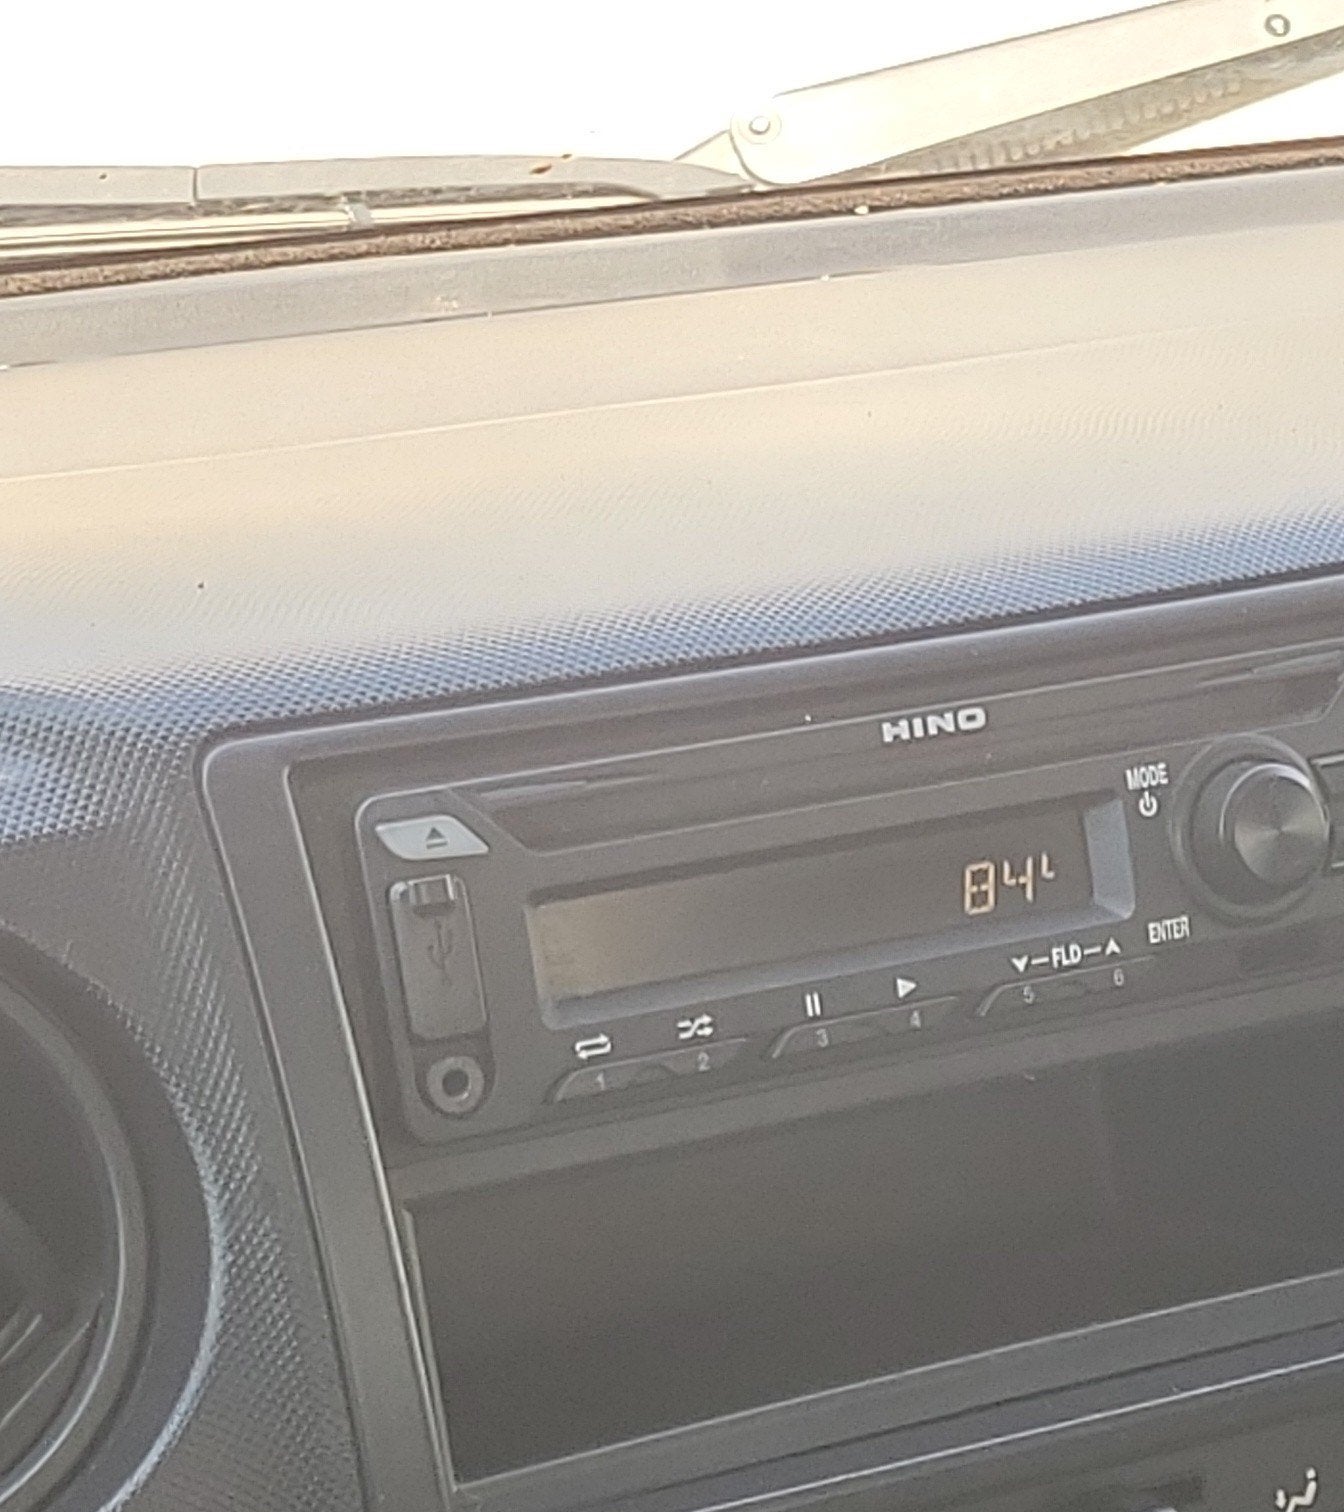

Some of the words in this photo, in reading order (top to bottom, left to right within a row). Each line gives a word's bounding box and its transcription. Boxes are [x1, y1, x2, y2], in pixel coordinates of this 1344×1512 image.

[881, 706, 987, 743] HINO
[1125, 762, 1169, 790] MODE
[1148, 916, 1190, 943] ENTER
[1051, 945, 1082, 968] FLD
[1113, 968, 1124, 986] 6
[816, 1028, 829, 1047] 3
[697, 1051, 711, 1071] 2
